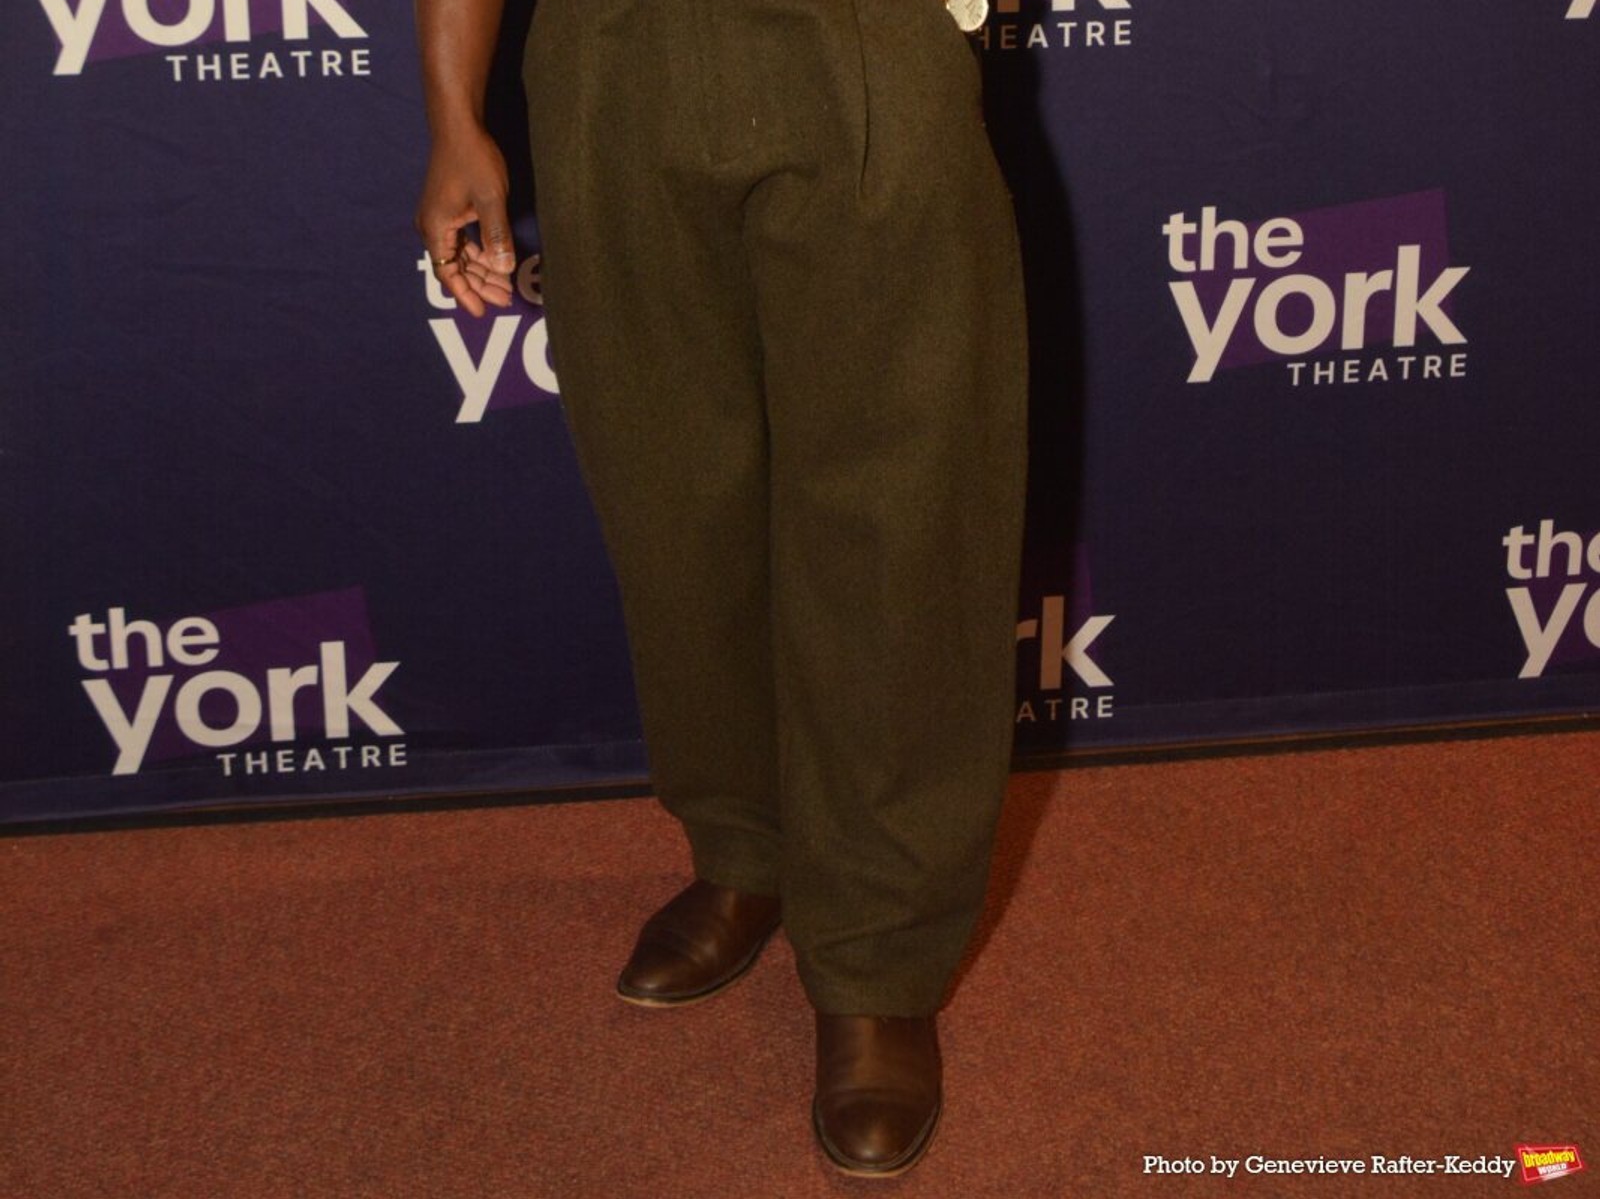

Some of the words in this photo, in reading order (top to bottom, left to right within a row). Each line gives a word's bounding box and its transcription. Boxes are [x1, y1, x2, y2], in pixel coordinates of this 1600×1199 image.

[166, 49, 371, 82] THEATRE
[1163, 206, 1304, 272] the
[1169, 245, 1471, 383] york
[1287, 354, 1467, 387] THEATRE
[1502, 519, 1600, 580] th
[68, 607, 220, 671] the
[81, 641, 405, 776] york
[1016, 696, 1114, 723] ATRE
[217, 744, 408, 777] THEATRE
